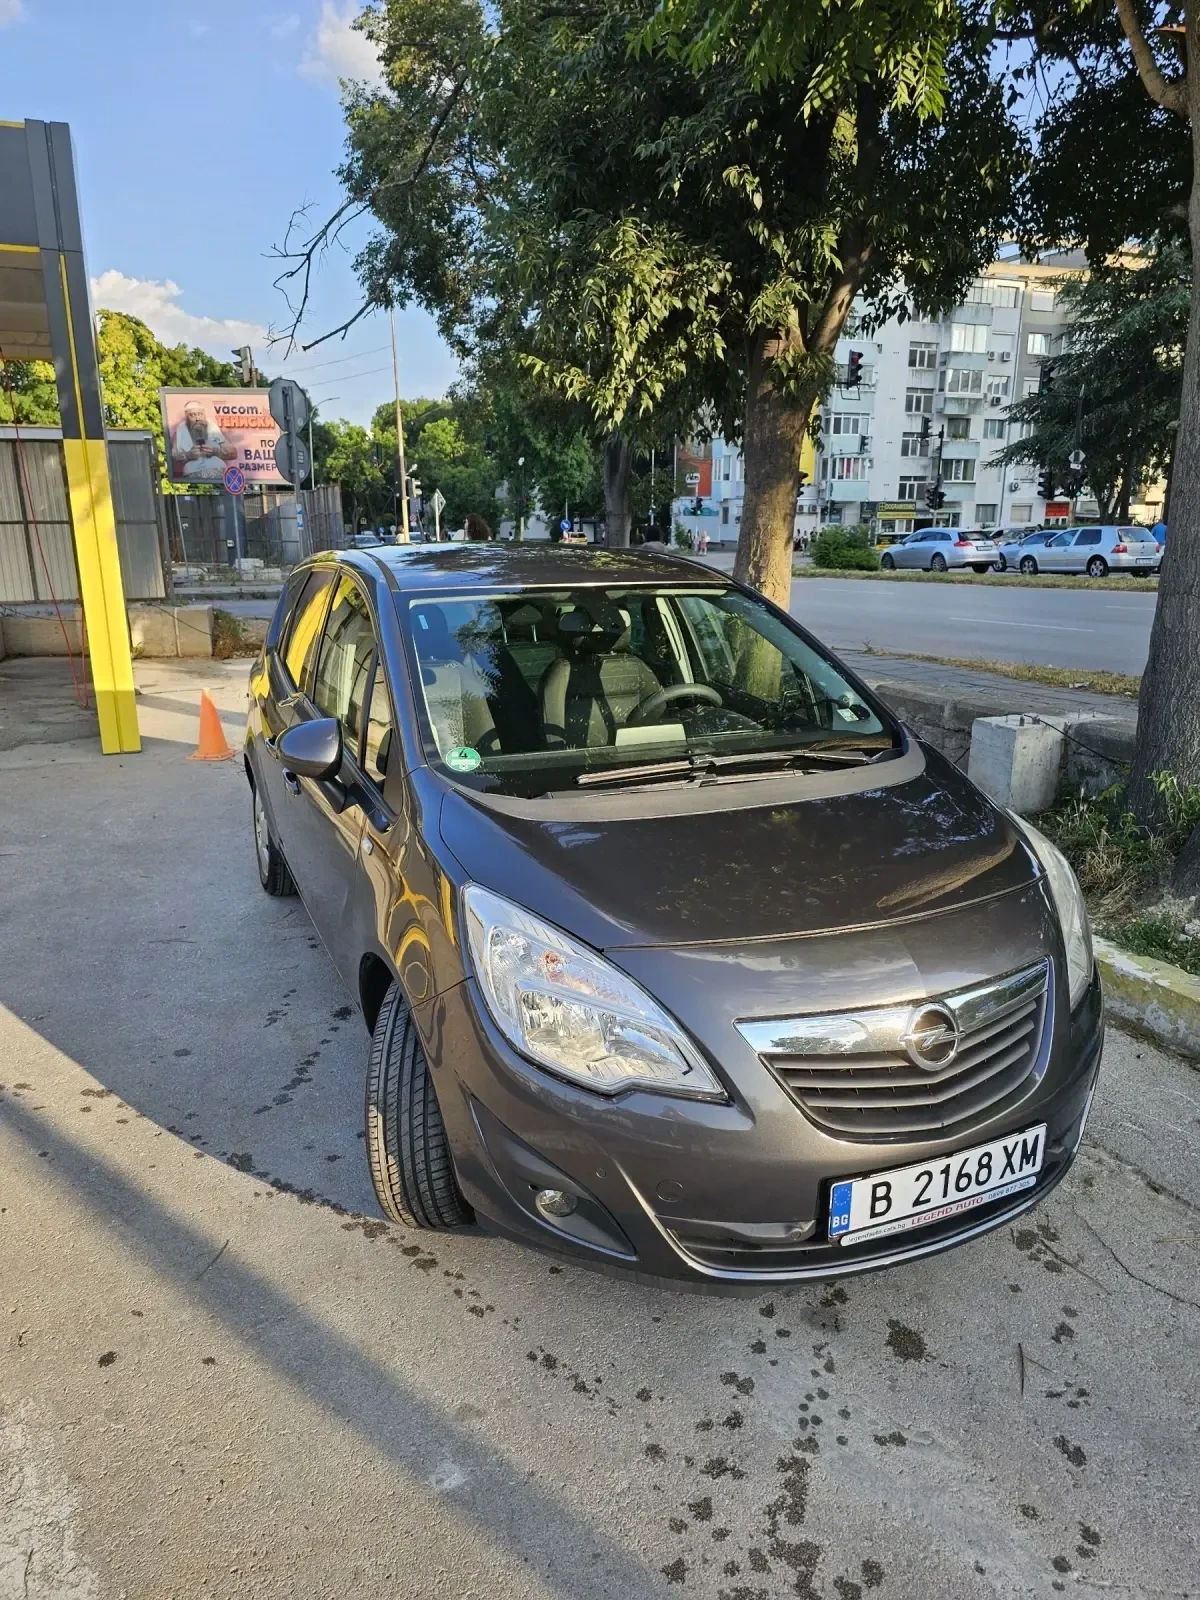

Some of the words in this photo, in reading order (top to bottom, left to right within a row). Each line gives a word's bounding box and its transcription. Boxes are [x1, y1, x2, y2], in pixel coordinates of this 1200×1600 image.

[217, 416, 275, 428] ТЕНИСКИ
[260, 439, 275, 448] ПО
[239, 463, 276, 471] РАЗМЕР
[458, 748, 468, 758] 4
[869, 1181, 892, 1220] B
[912, 1151, 993, 1208] 2168
[999, 1134, 1040, 1180] XM
[832, 1213, 849, 1228] BG
[848, 1223, 906, 1243] legendauto.cars.bg
[911, 1206, 953, 1226] LEGEND
[955, 1196, 984, 1211] AUTO
